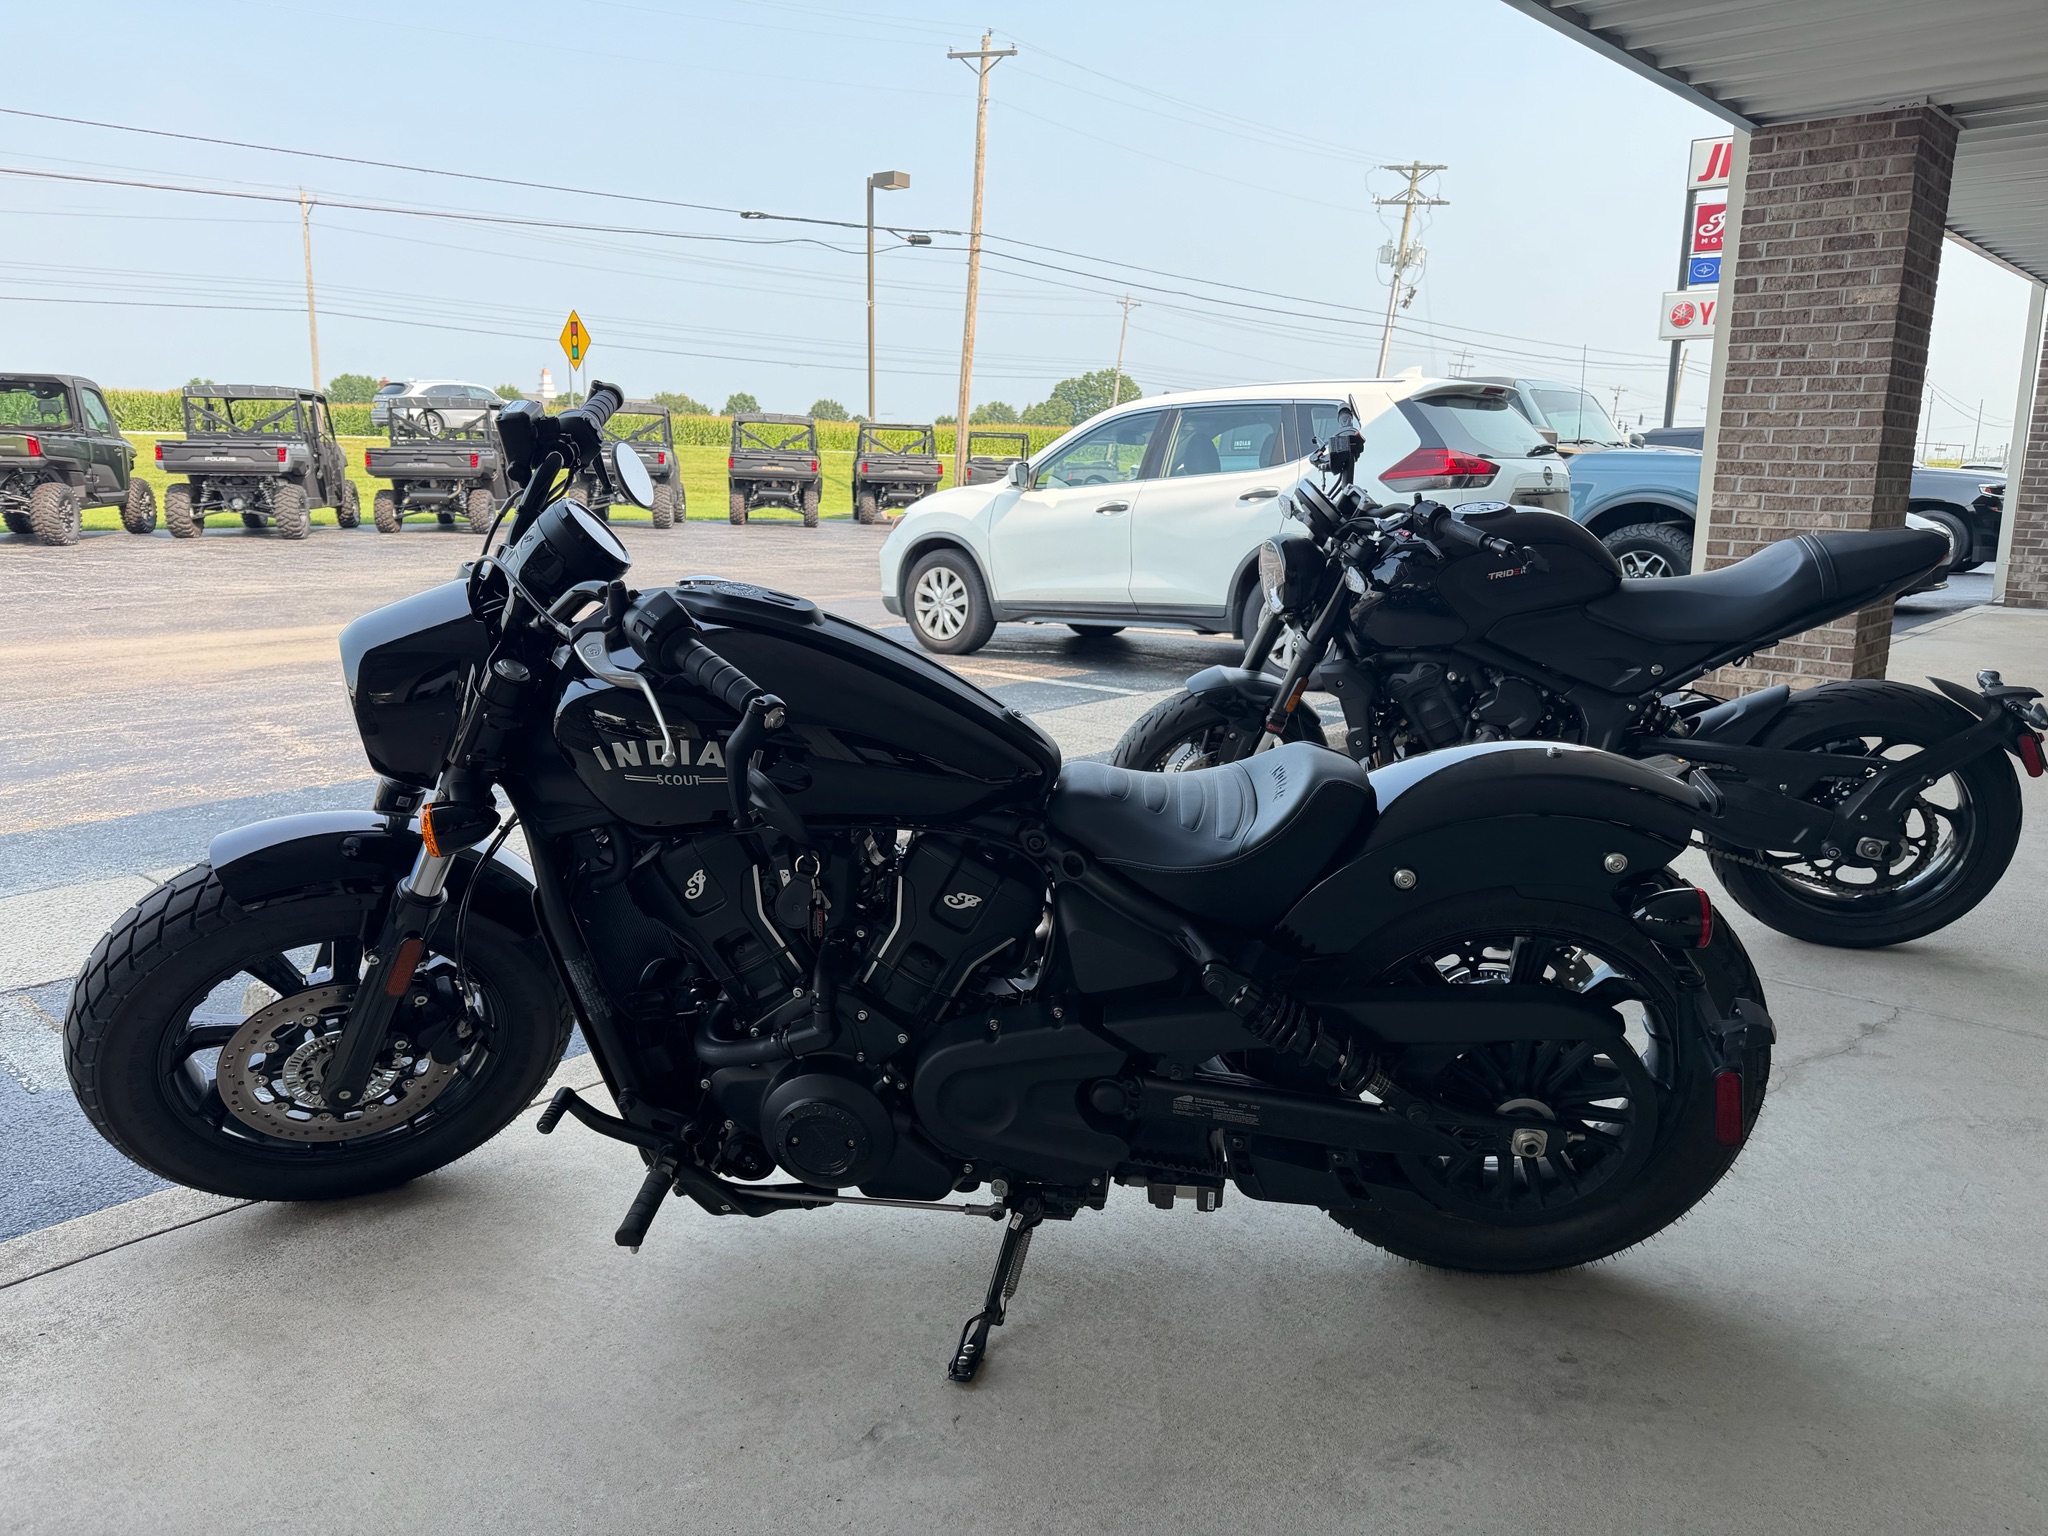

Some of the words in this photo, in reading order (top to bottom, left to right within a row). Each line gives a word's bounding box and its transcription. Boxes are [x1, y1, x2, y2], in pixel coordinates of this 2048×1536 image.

[1699, 301, 1716, 325] Y
[593, 739, 764, 771] INDIA
[656, 774, 700, 786] SCOUT
